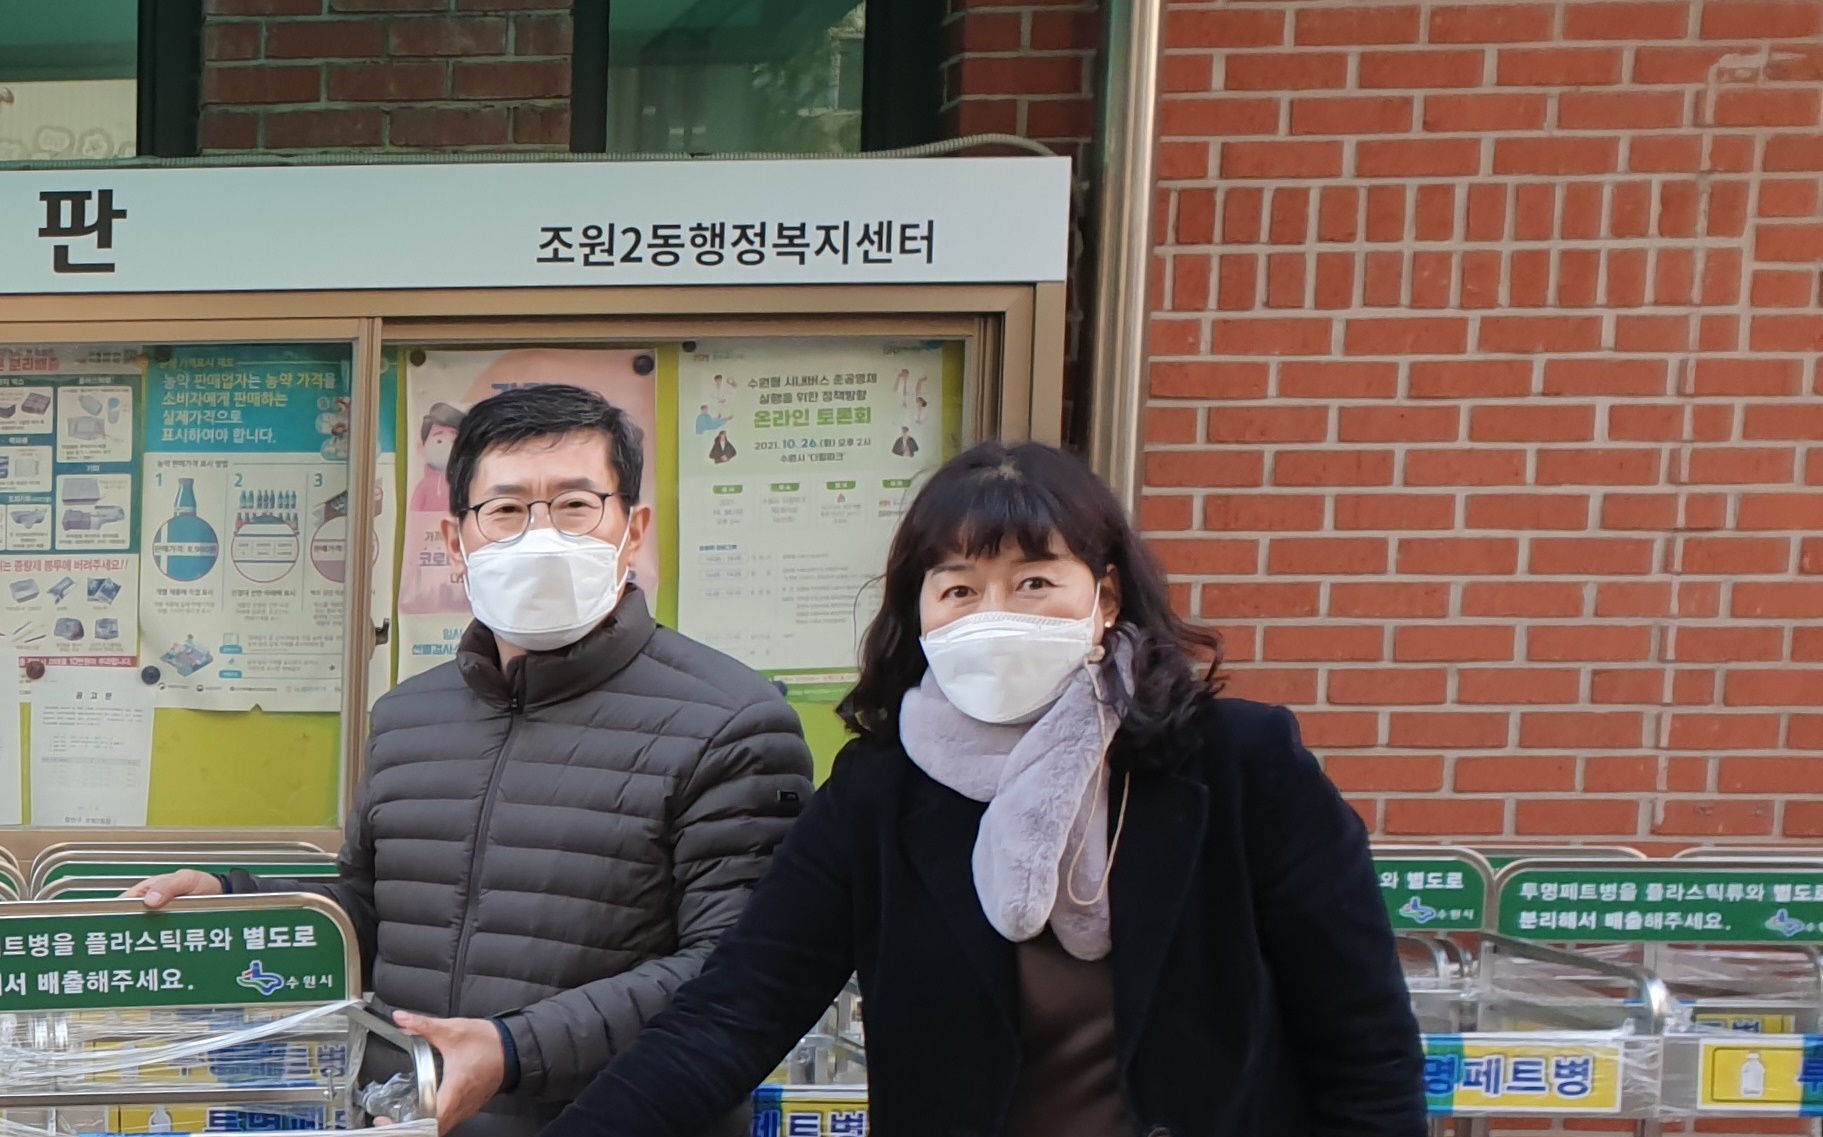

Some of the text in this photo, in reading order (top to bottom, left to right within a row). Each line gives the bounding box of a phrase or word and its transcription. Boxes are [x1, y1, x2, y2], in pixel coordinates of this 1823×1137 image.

[536, 219, 936, 267] 조원2동행정복지센터
[753, 406, 872, 429] 온라인 토론회
[232, 428, 276, 444] 합니다.
[155, 473, 324, 488] 1 2 3
[1406, 871, 1465, 890] 별도로
[1517, 882, 1638, 901] 투명페트병을
[1645, 882, 1766, 902] 플라스틱류와
[1518, 911, 1732, 931] 분리해서 배출해주세요.
[84, 926, 233, 955] 플라스틱류와
[242, 924, 318, 950] 별도로
[37, 967, 194, 995] 배출해주세요.
[285, 974, 333, 990] 수원시
